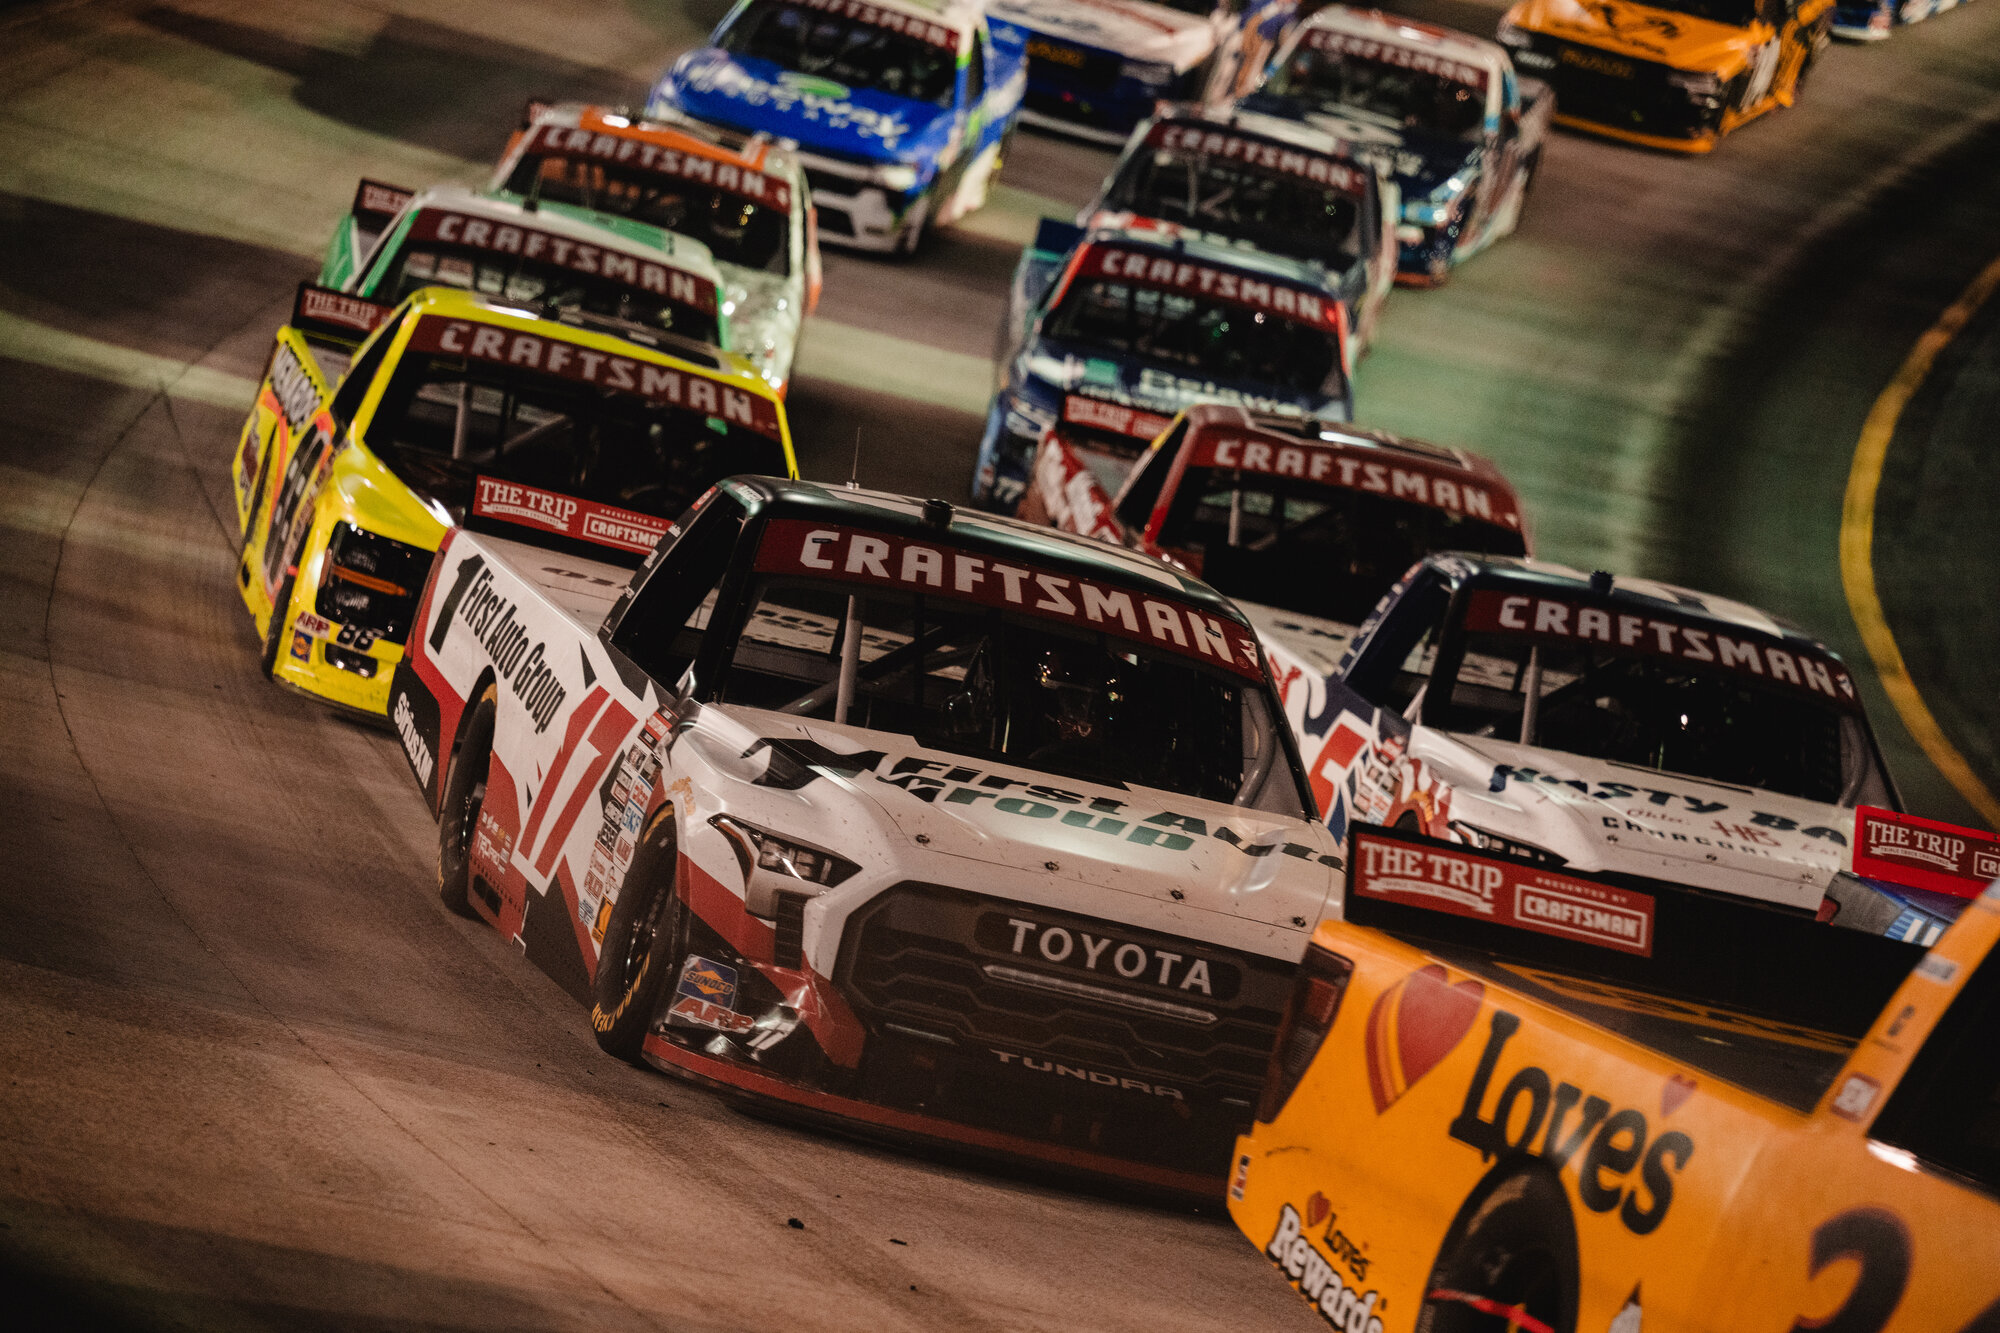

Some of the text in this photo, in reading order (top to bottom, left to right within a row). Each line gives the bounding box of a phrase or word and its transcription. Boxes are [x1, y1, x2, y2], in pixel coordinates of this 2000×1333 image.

[545, 127, 766, 196] CRAFTSMAN
[1162, 126, 1352, 191] CRAFTSMAN
[437, 217, 698, 300] CRAFTSMAN
[1101, 252, 1324, 321] CRAFTSMAN
[440, 323, 753, 424] CRAFTSMAN
[480, 479, 577, 522] THE TRIP
[1214, 439, 1491, 514] CRAFTSMAN
[296, 611, 331, 633] ARP
[799, 529, 1236, 666] CRAFTSMAN
[460, 566, 566, 735] First Auto Group
[1498, 595, 1840, 699] CRAFTSMAN
[1360, 841, 1423, 877] THE
[1427, 854, 1502, 899] TRIP
[1867, 820, 1965, 862] THE TRIP
[1524, 895, 1639, 939] CRAFTSMAN
[687, 971, 733, 994] SUNOCO
[1008, 918, 1212, 996] TOYOTA
[675, 997, 754, 1032] ARP
[990, 1048, 1184, 1100] TUNDRA
